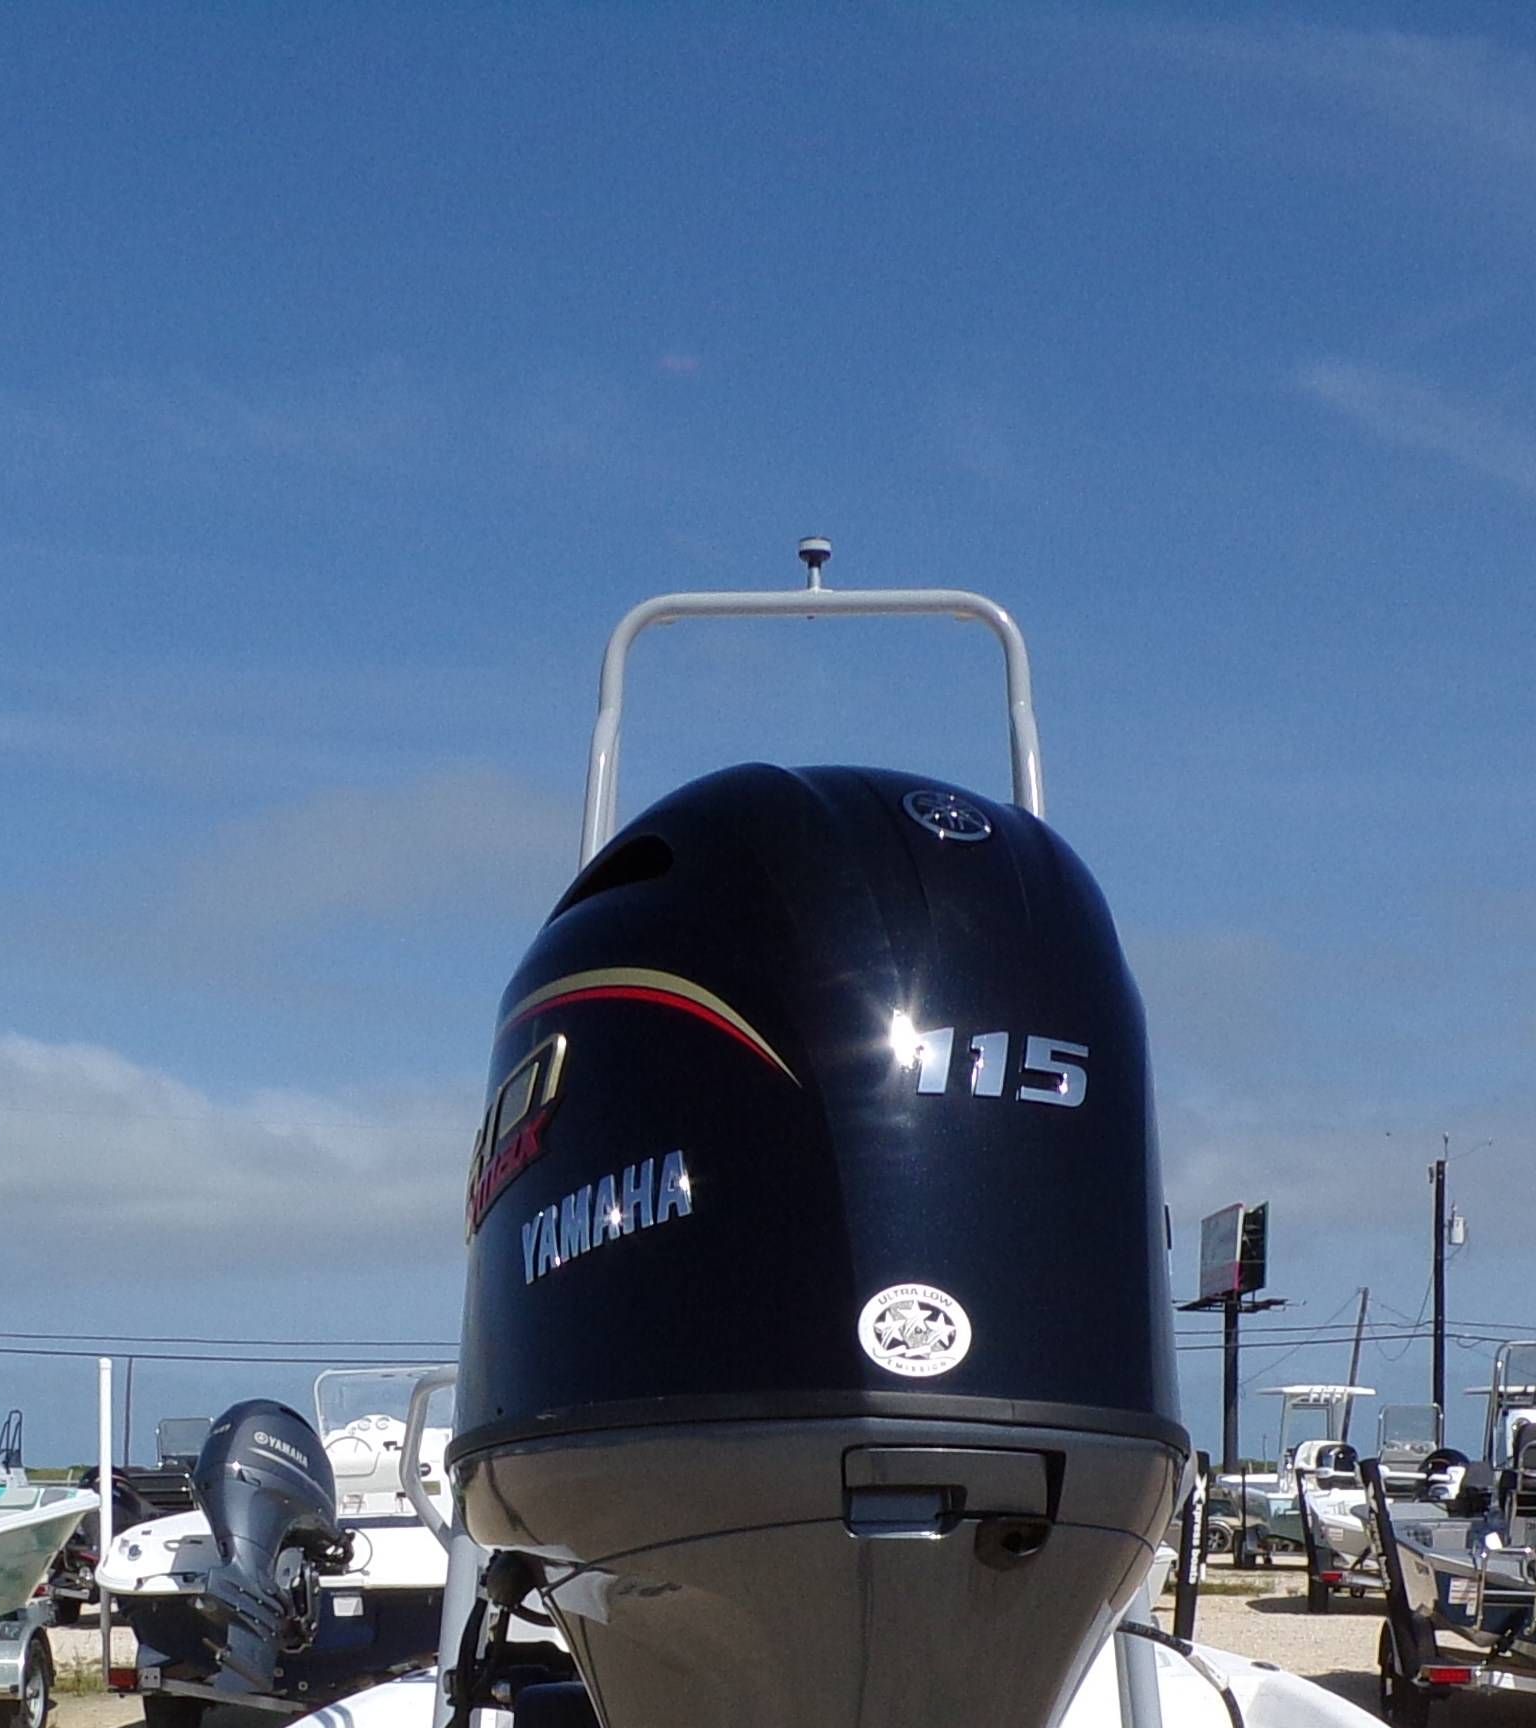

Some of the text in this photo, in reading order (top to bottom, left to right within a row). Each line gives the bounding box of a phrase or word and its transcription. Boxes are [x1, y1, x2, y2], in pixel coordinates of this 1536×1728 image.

[914, 1026, 1090, 1109] 115
[521, 1149, 693, 1286] YAMAHA
[877, 1287, 953, 1307] ULTRA LOW
[269, 1436, 309, 1469] YAMAHA
